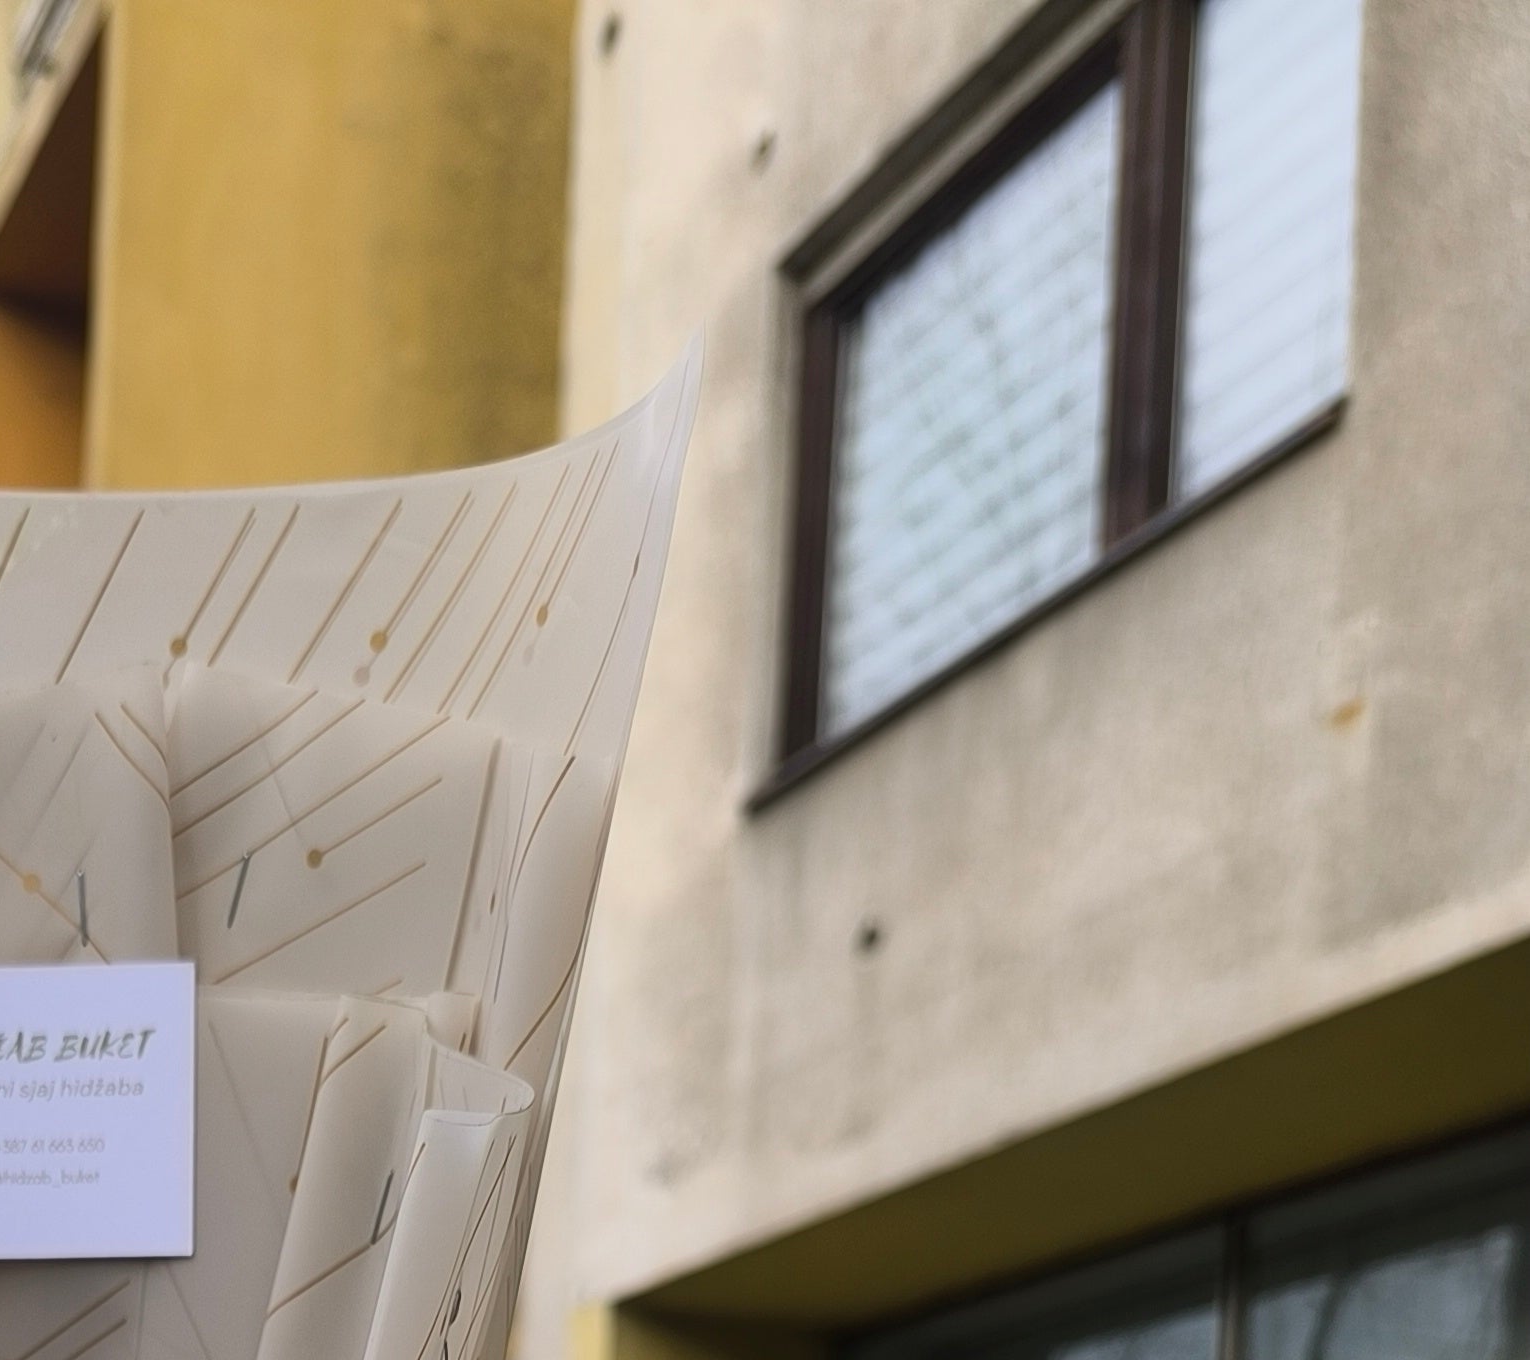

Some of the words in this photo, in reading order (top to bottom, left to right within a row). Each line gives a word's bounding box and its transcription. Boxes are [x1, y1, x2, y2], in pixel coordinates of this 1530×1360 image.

[54, 1029, 157, 1063] BUKET
[19, 1080, 56, 1102] sjaj
[60, 1077, 145, 1098] hidžaba
